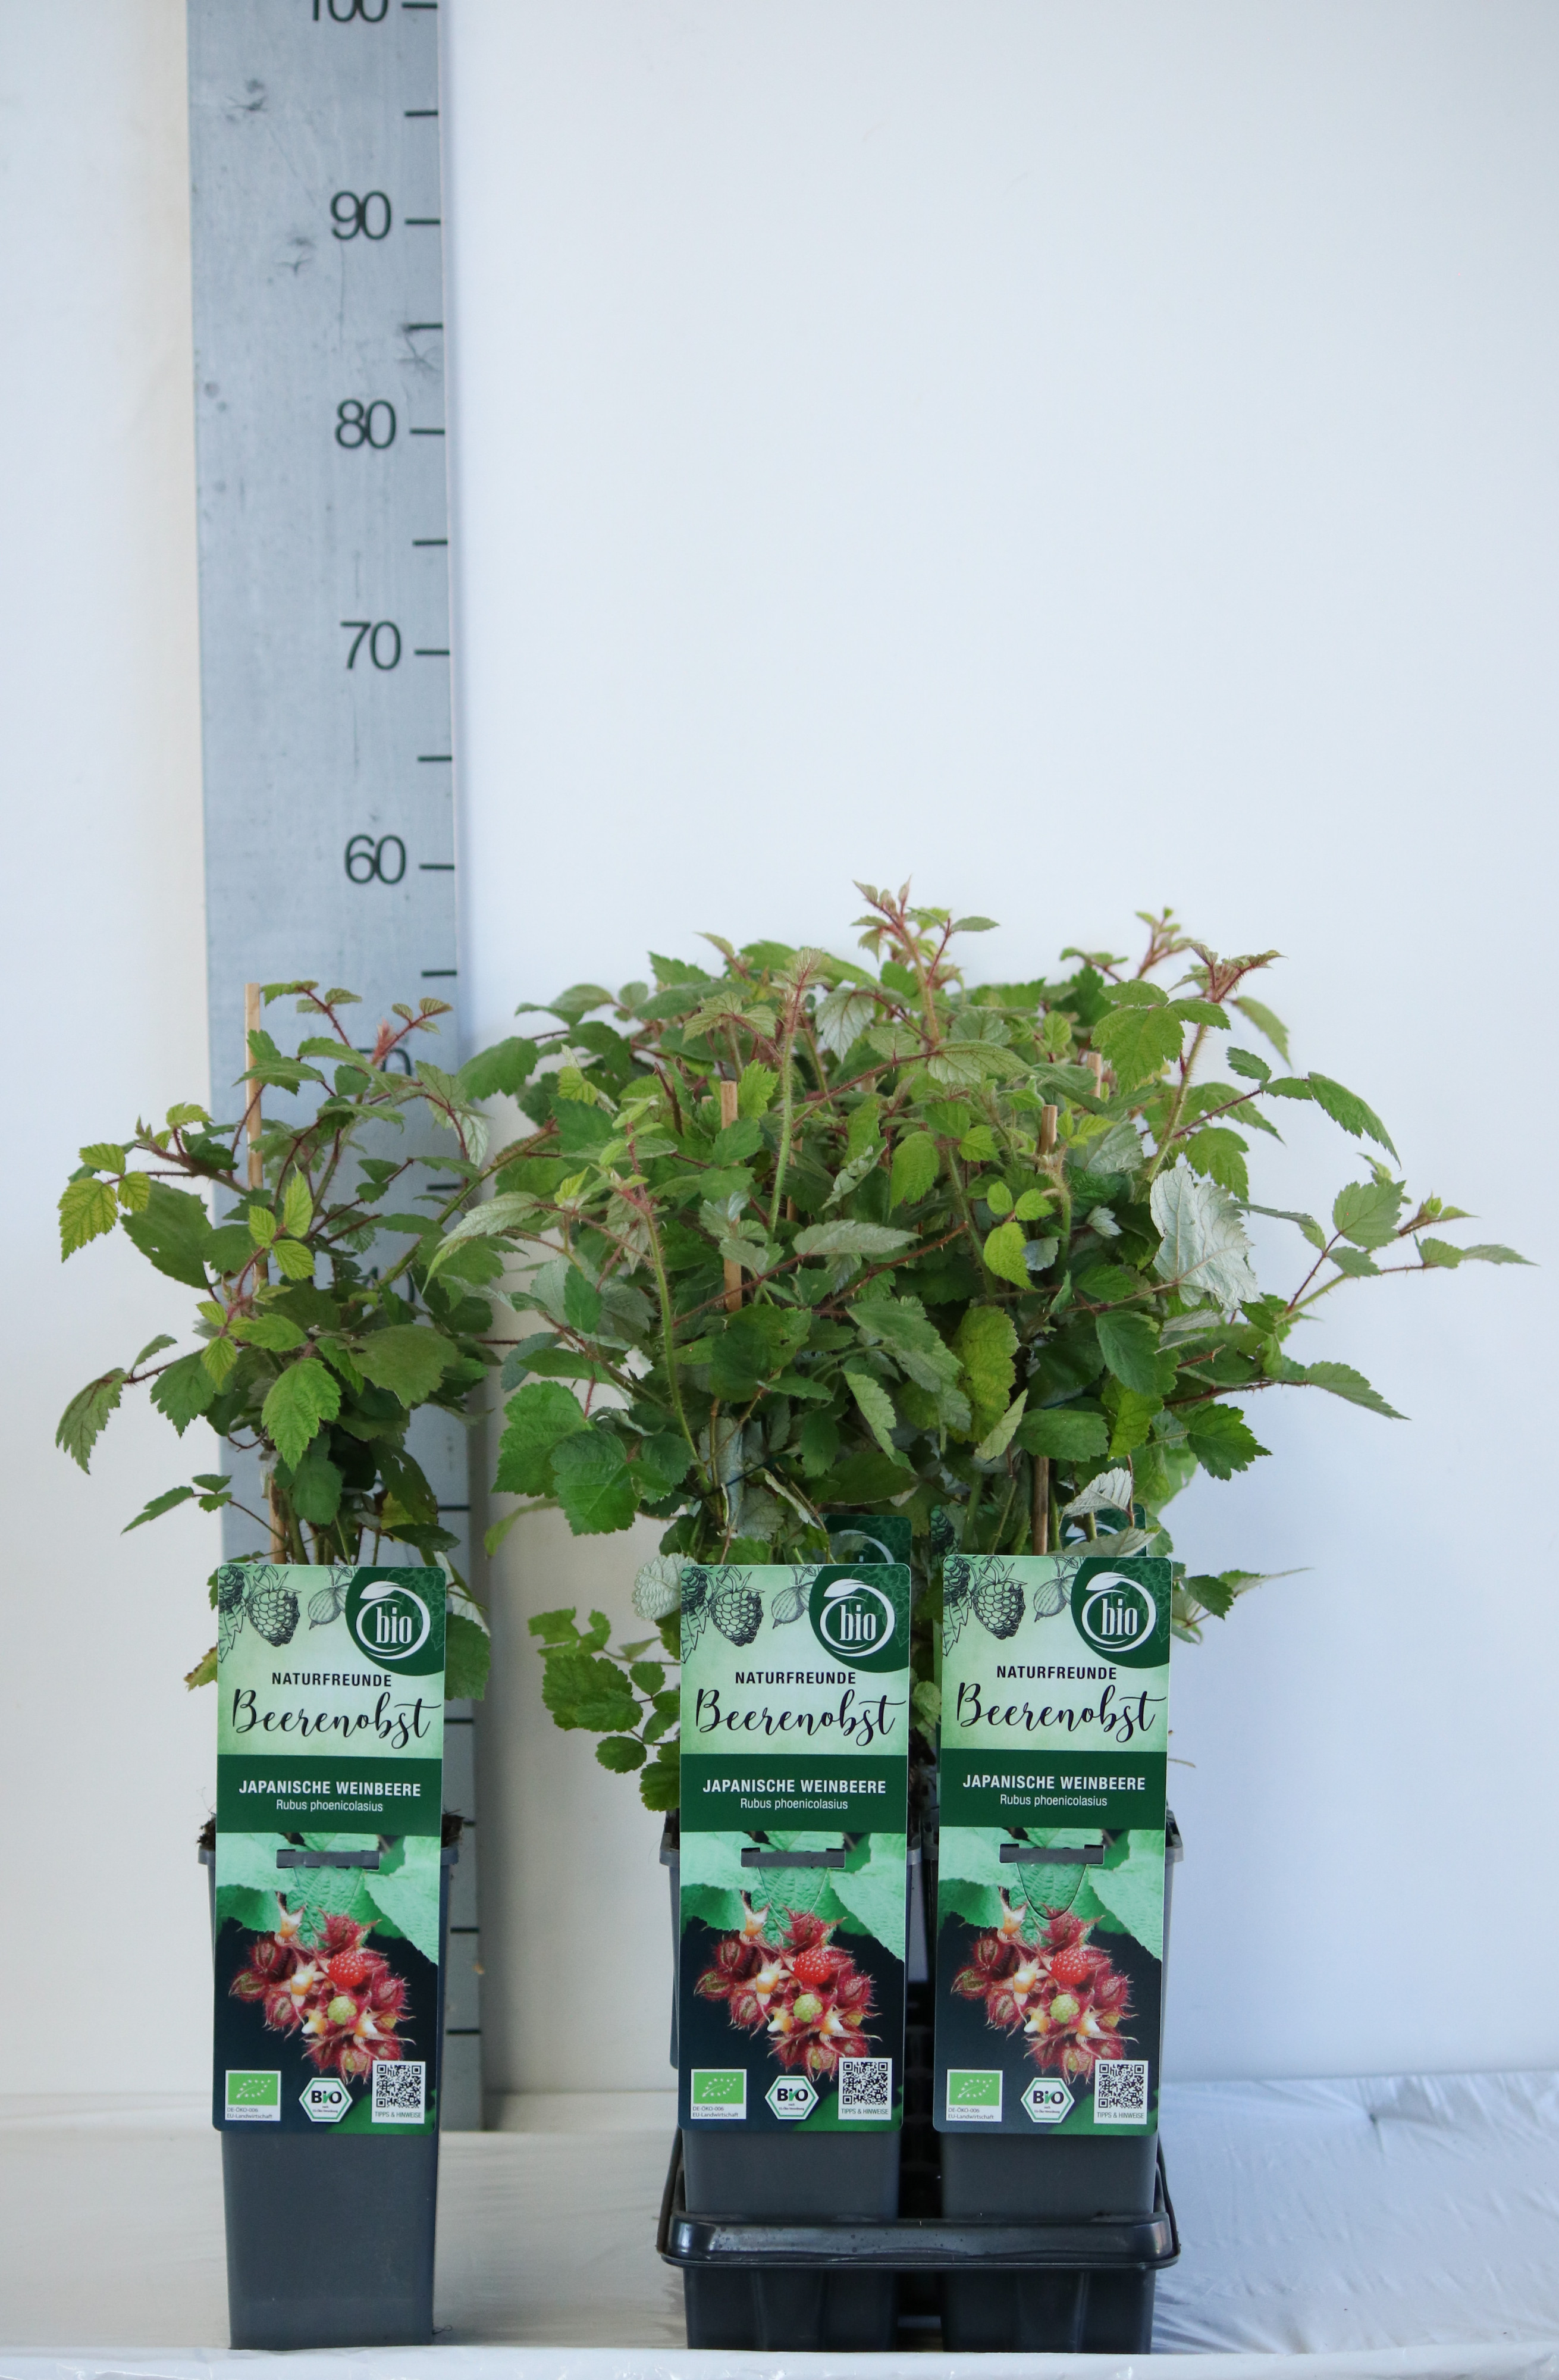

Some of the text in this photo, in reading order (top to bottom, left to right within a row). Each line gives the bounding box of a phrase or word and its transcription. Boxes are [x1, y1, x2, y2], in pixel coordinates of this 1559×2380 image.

[331, 191, 391, 240] 90
[335, 400, 396, 449] 80
[341, 621, 401, 671] 70
[344, 834, 406, 885] 60
[376, 1607, 412, 1643] bio
[839, 1605, 876, 1641] bio
[1100, 1598, 1138, 1636] bio
[272, 1672, 392, 1687] NATURFREUNDE
[735, 1671, 857, 1684] NATURFREUNDE
[997, 1665, 1117, 1680] NATURFREUNDE
[233, 1688, 441, 1749] Beerenobst
[696, 1689, 906, 1746] Beerenobst
[956, 1682, 1167, 1743] Beerenobst
[239, 1780, 421, 1797] JAPANISCHE WEINBEERE
[702, 1779, 886, 1794] JAPANISCHE WEINBEERE
[962, 1774, 1146, 1790] JAPANISCHE WEINBEERE
[276, 1799, 383, 1812] Rubus phoenicolasius
[741, 1797, 848, 1811] Rubus phoenicolasius
[1000, 1794, 1108, 1808] Rubus phoenicolasius
